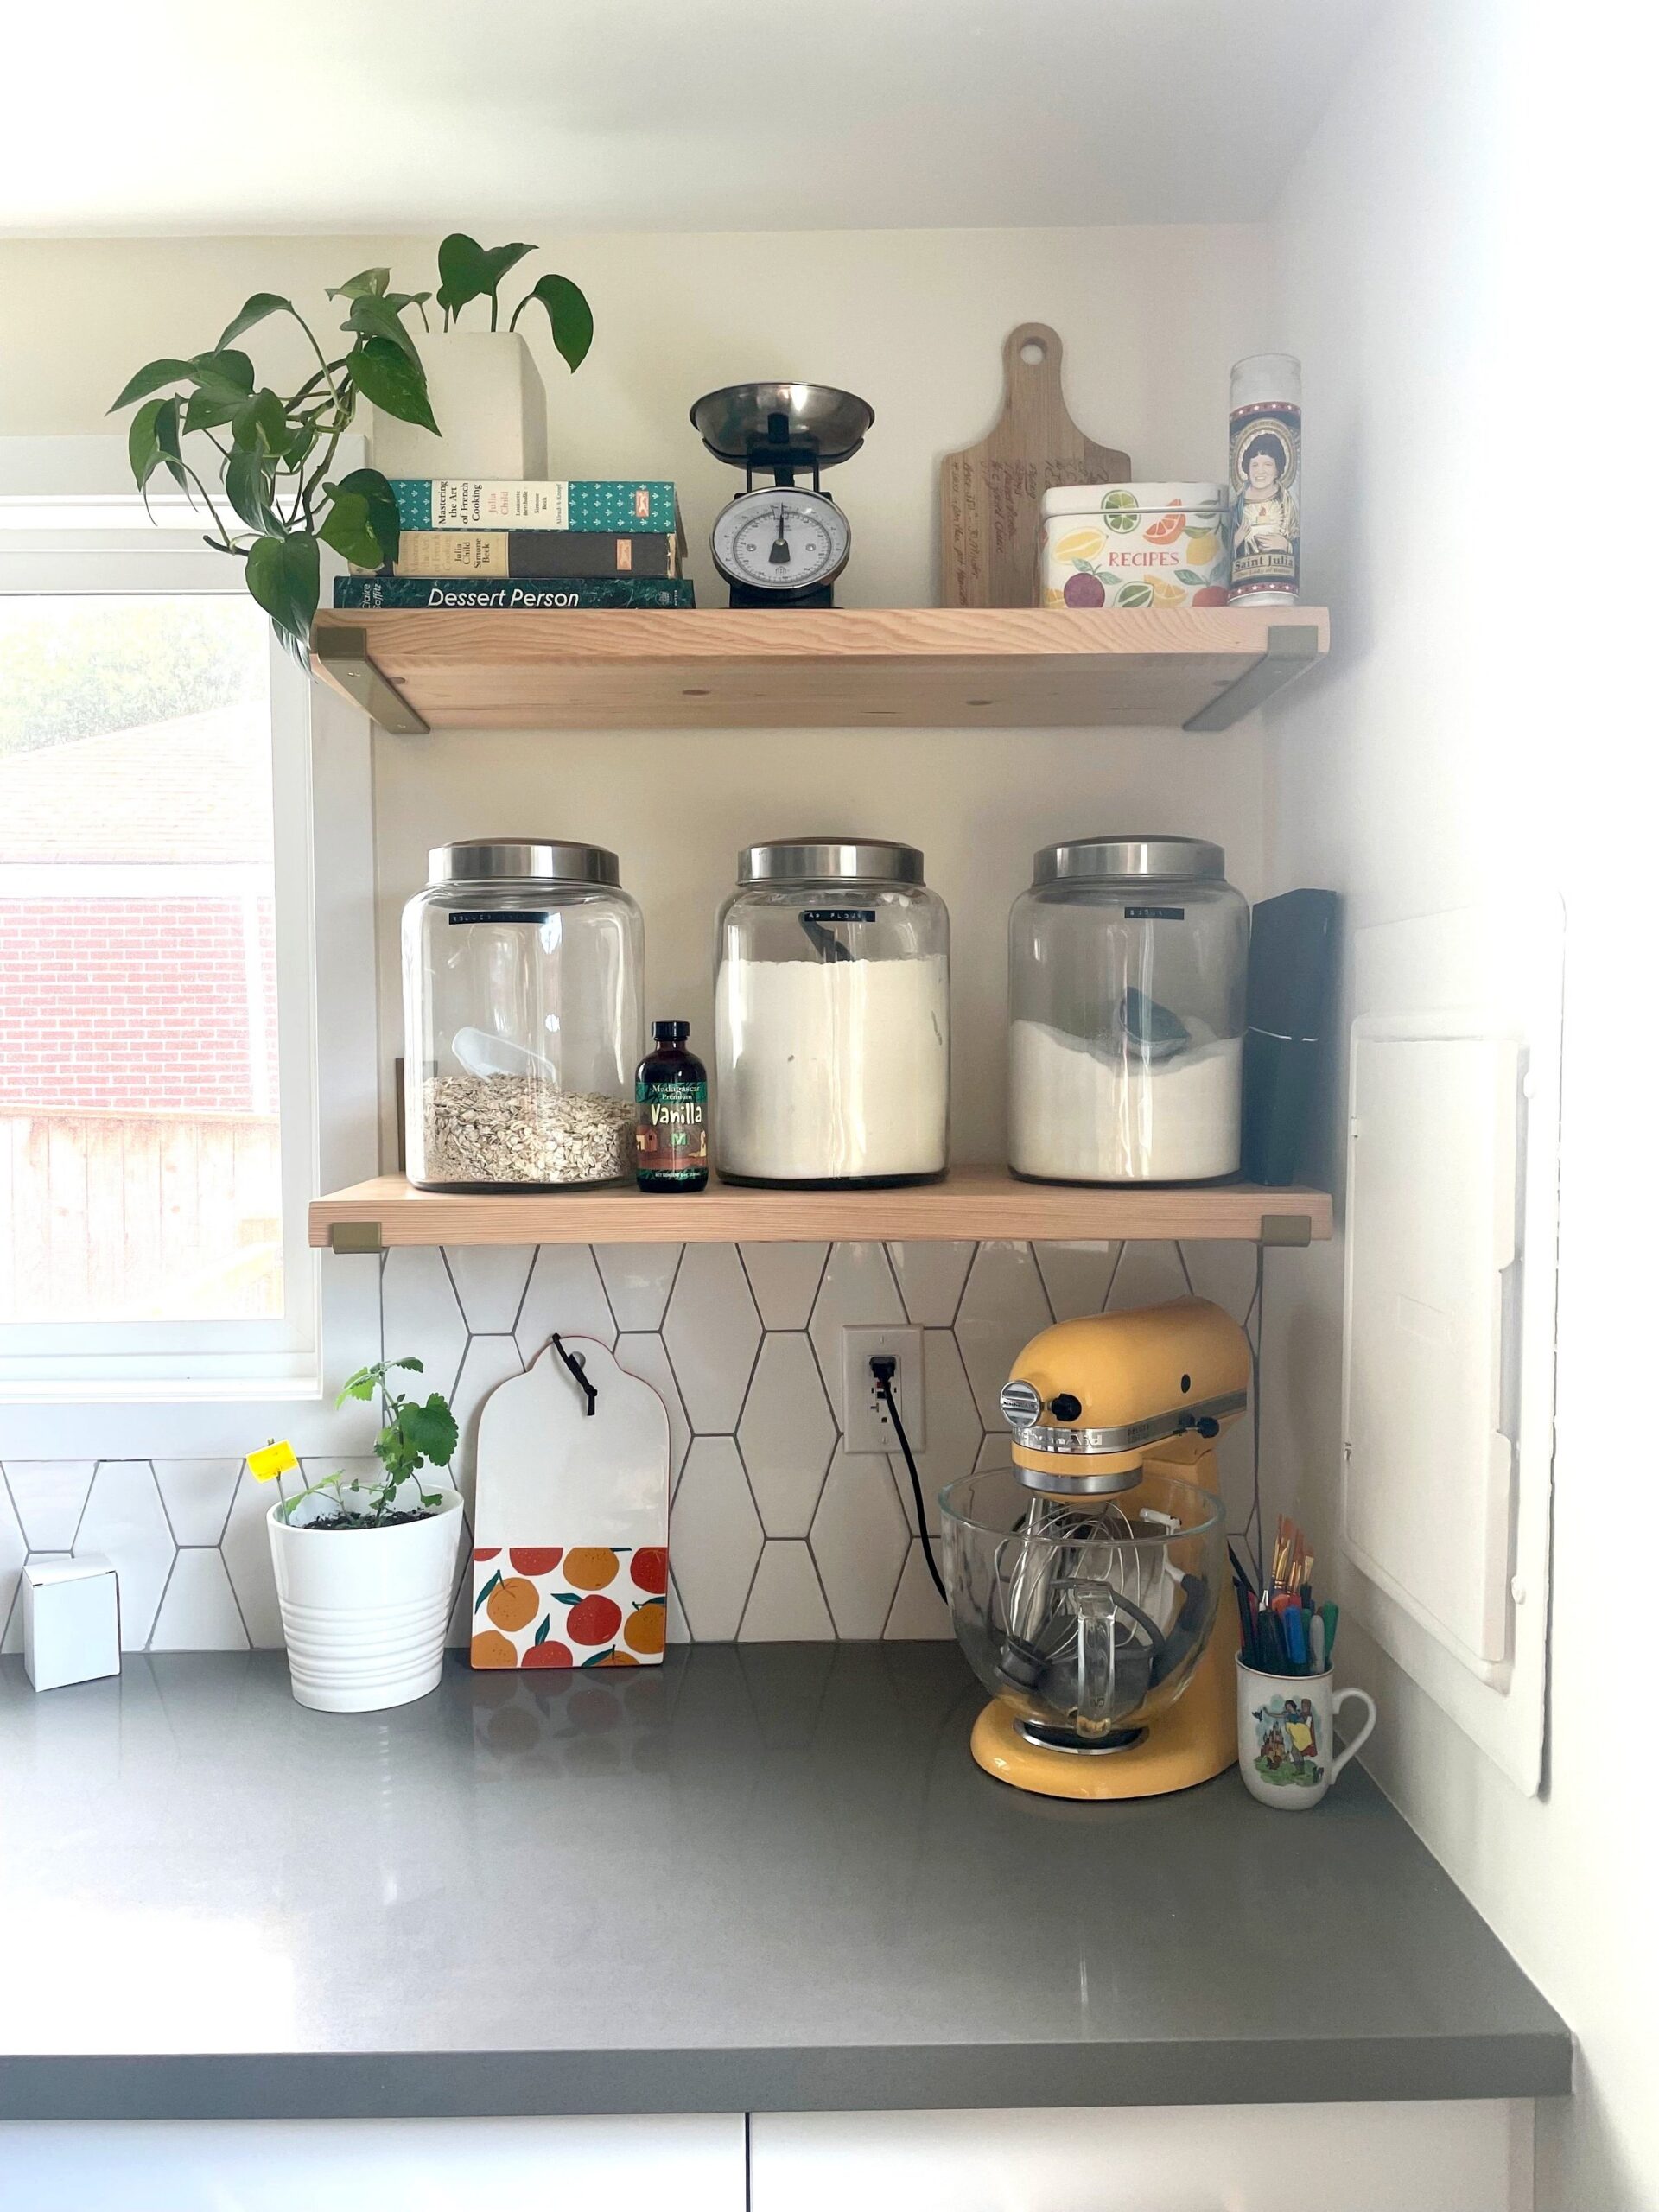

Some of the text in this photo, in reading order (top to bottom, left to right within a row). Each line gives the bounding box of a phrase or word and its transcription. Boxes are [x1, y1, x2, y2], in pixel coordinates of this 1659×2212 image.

[438, 481, 450, 524] Mastering
[460, 482, 468, 524] of French
[472, 484, 482, 522] Cooking
[488, 493, 498, 514] Julia
[500, 491, 509, 516] Child
[454, 543, 463, 563] Julia
[482, 543, 491, 563] Beck
[1109, 551, 1179, 567] RECIPES
[1235, 555, 1294, 569] Saint Julia
[428, 588, 579, 607] Dessert Person
[652, 1084, 700, 1096] Madagascar
[651, 1102, 702, 1126] Vanilla
